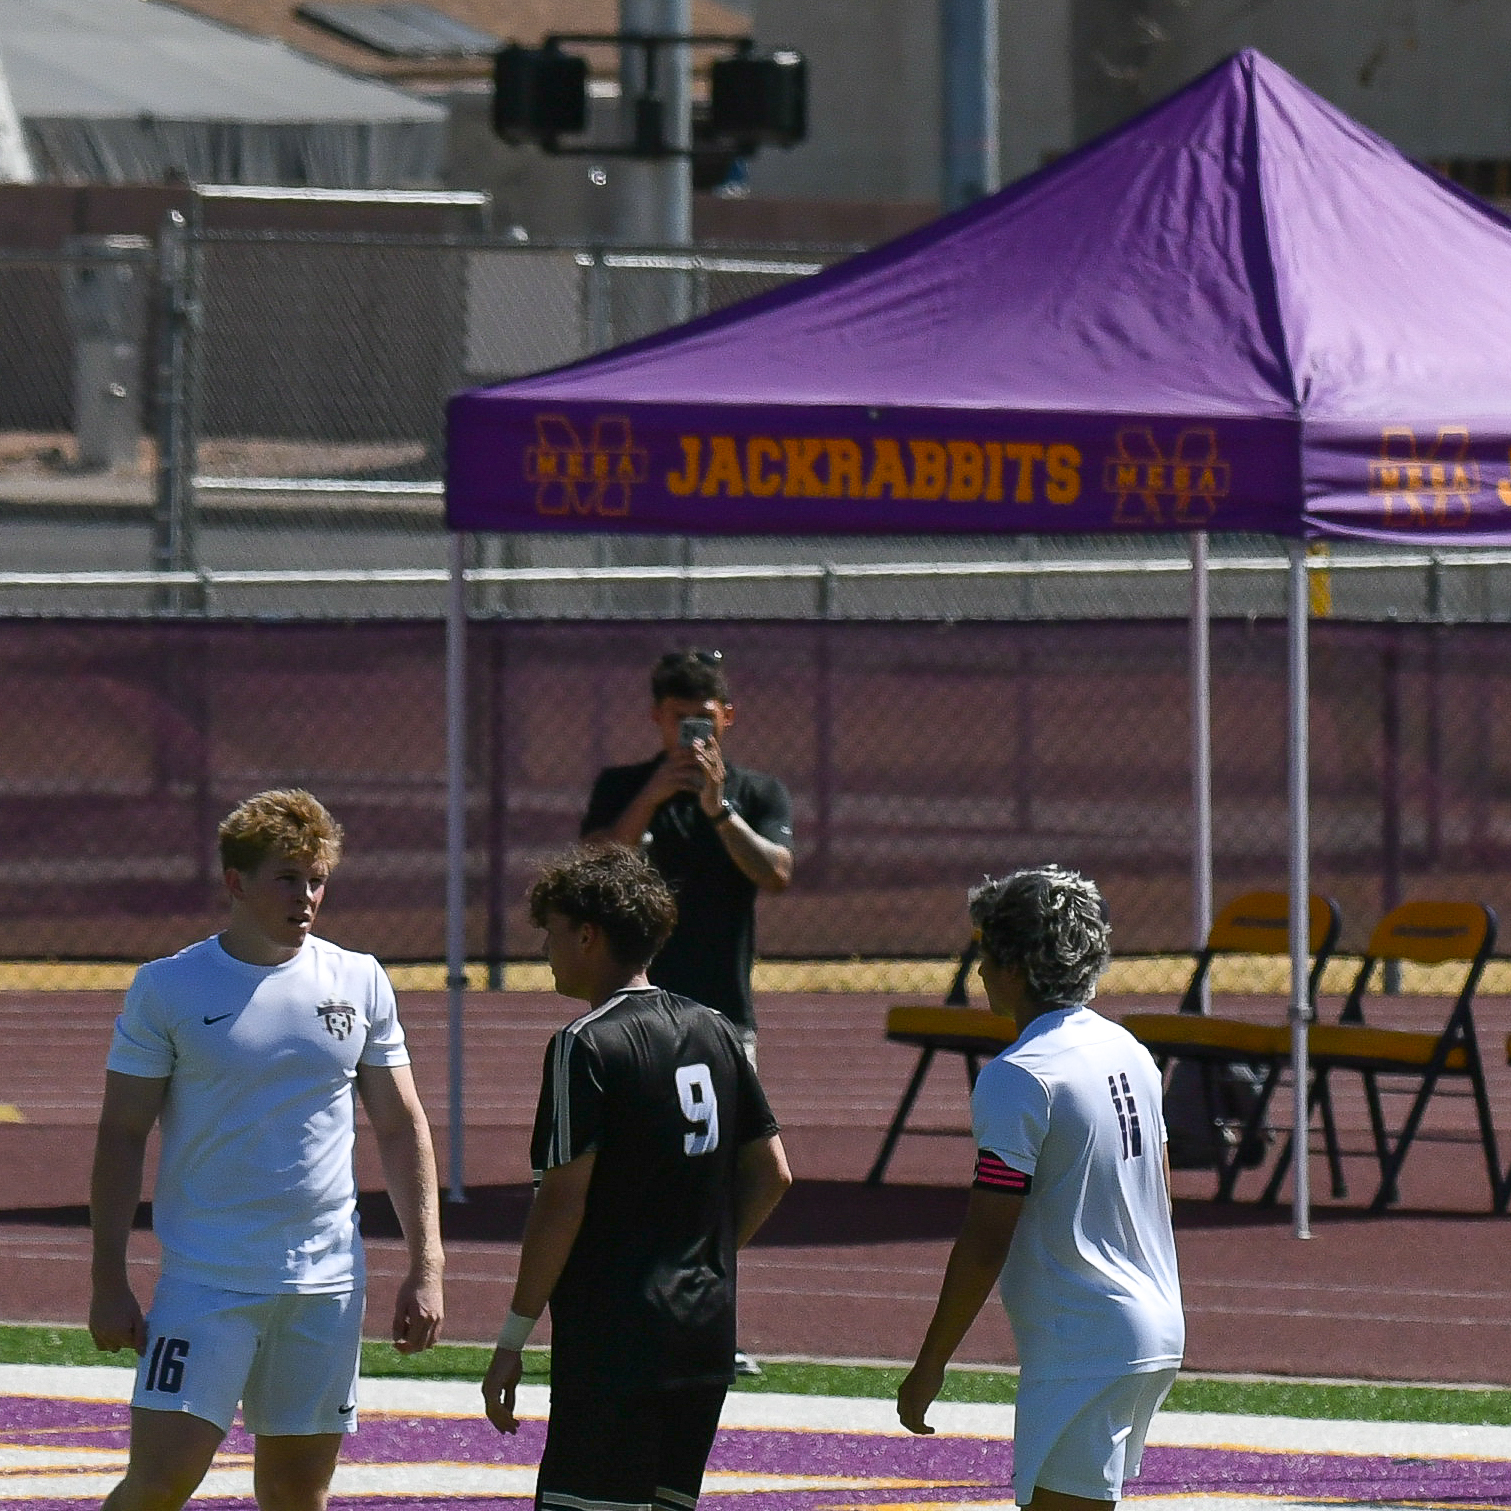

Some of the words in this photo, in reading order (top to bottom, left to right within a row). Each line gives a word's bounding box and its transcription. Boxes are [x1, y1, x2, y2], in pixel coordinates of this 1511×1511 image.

[666, 436, 1082, 504] JACKRABBITS
[675, 1062, 720, 1157] 9
[1107, 1072, 1142, 1162] 11
[144, 1335, 191, 1394] 16
